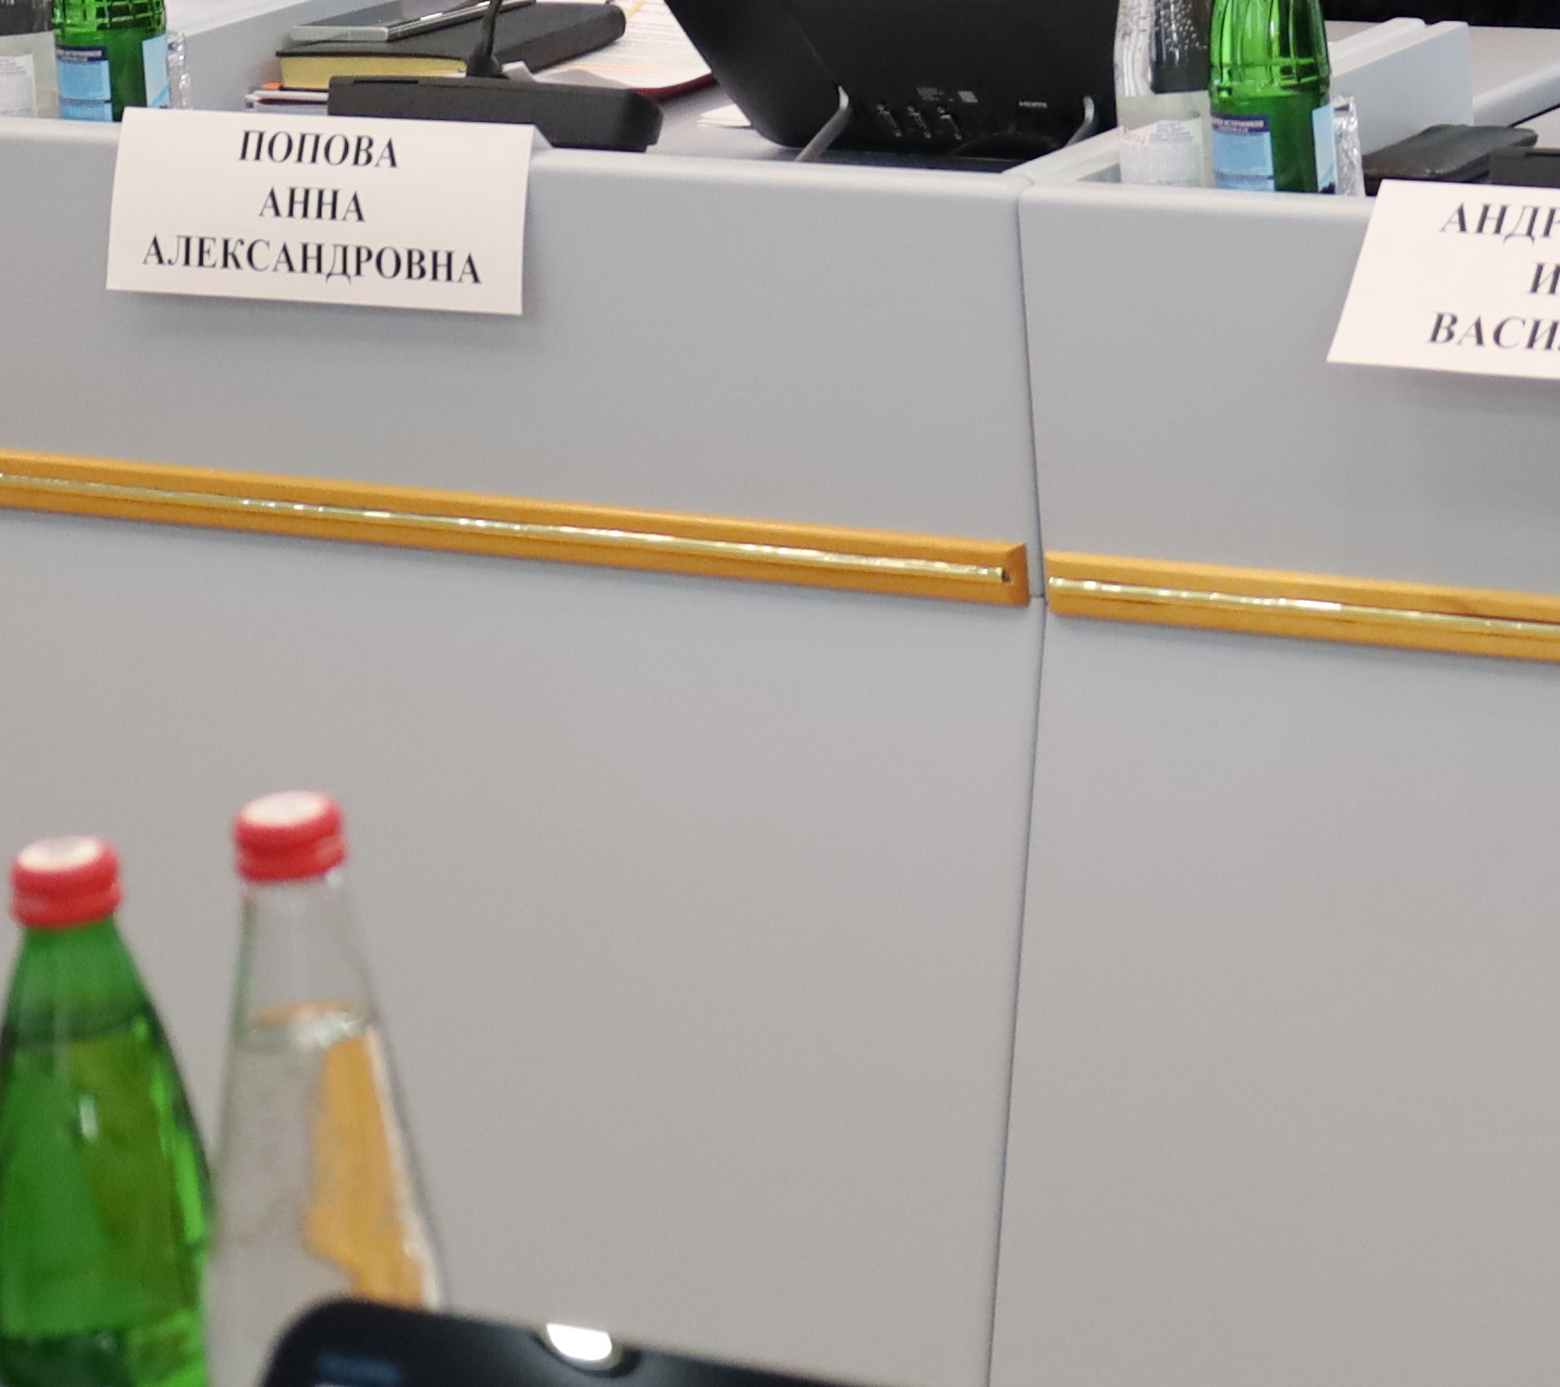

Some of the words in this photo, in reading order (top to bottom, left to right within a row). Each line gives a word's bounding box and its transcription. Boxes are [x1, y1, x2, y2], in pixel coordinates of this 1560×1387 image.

[238, 130, 399, 168] ПОПОВА
[259, 186, 366, 223] АННА
[142, 234, 482, 285] АЛЕКСАНДРОВНА
